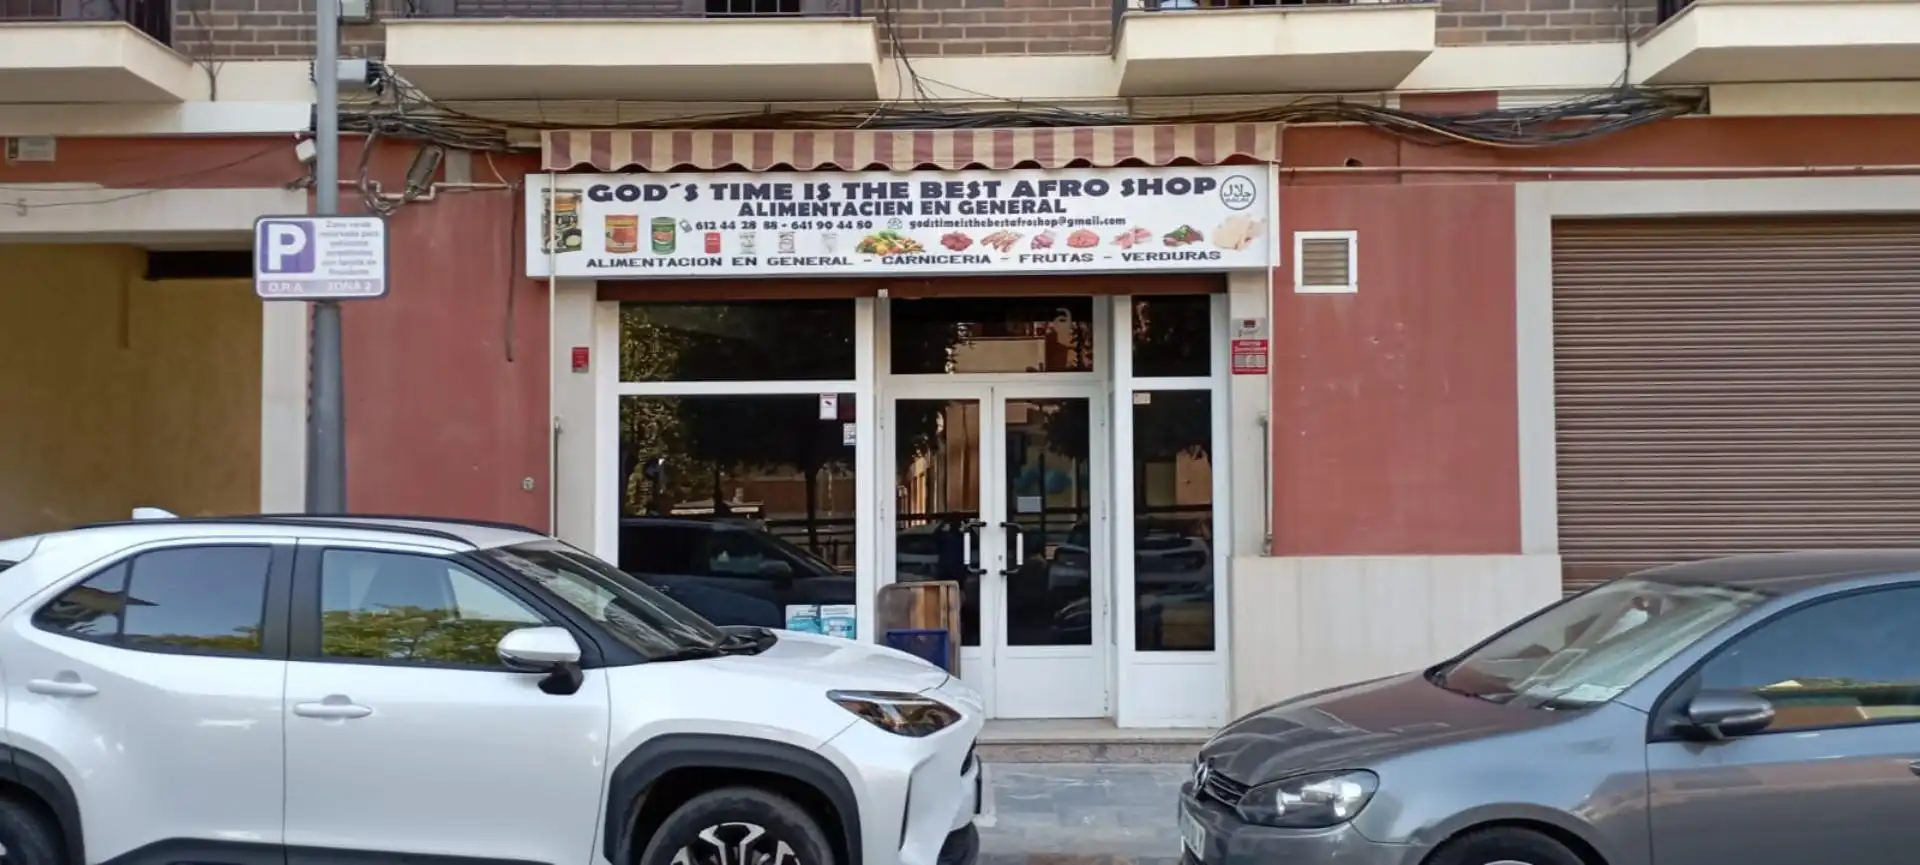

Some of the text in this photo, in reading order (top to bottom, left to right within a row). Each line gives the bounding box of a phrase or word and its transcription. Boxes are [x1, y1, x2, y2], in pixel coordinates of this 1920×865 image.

[709, 183, 793, 201] TIME
[804, 183, 832, 202] IS
[842, 182, 909, 200] THE
[920, 180, 1001, 199] BEST
[1011, 178, 1110, 198] AFRO
[1120, 176, 1217, 197] SHOP
[738, 198, 1067, 217] ALIMENTACIEN EN GENERAL
[695, 221, 717, 231] 612
[720, 221, 736, 230] 44
[741, 220, 757, 230] 28
[791, 220, 812, 230] 641
[816, 220, 833, 229] 90
[837, 220, 853, 229] 44
[909, 216, 1127, 230] godstimeisthebestafroshop@gmail.com
[268, 223, 306, 271] P
[586, 257, 722, 268] ALIMENTACION
[732, 257, 757, 266] EN
[767, 256, 854, 266] GENERAL
[882, 255, 991, 265] CARNICERIA
[1019, 252, 1094, 263] FRUTAS
[1121, 251, 1221, 262] VERDURAS
